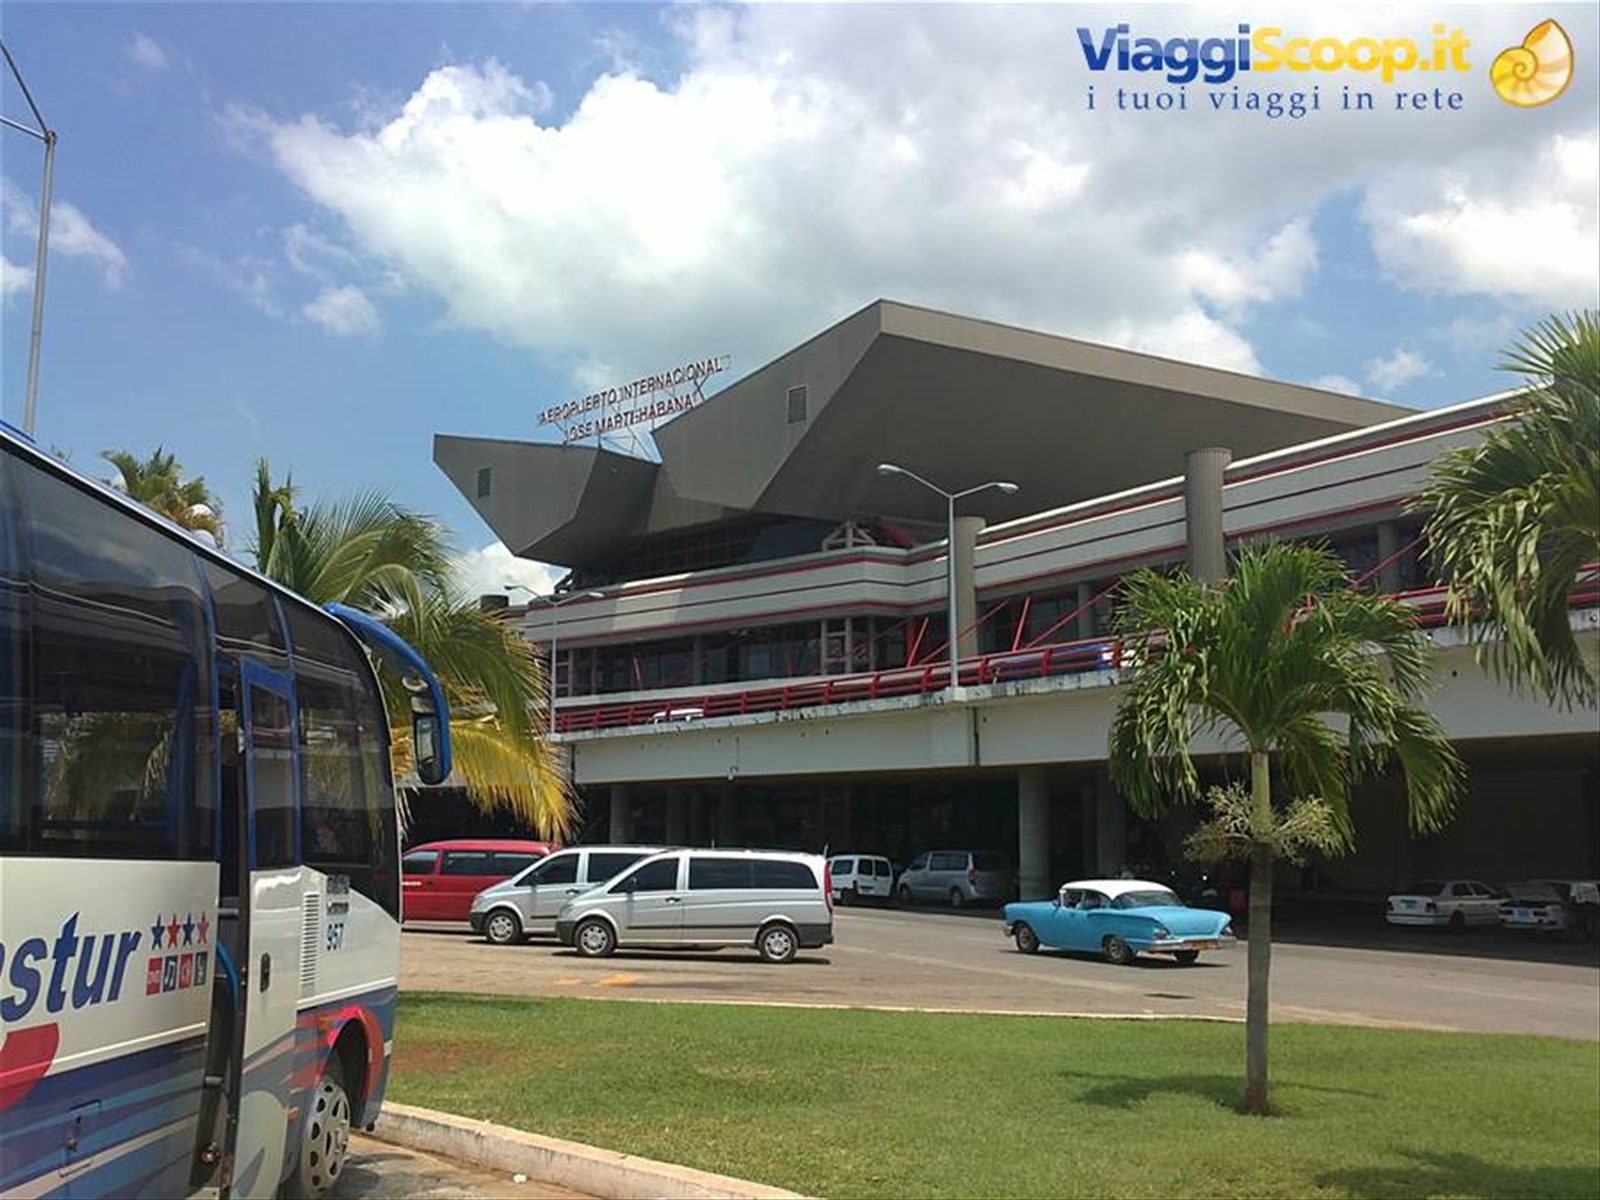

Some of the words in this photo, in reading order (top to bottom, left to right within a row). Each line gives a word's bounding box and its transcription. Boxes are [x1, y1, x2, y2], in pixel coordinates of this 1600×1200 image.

[537, 387, 617, 426] AEROPUERTO
[618, 357, 723, 402] INTERNACIONAL
[0, 911, 142, 1022] stur
